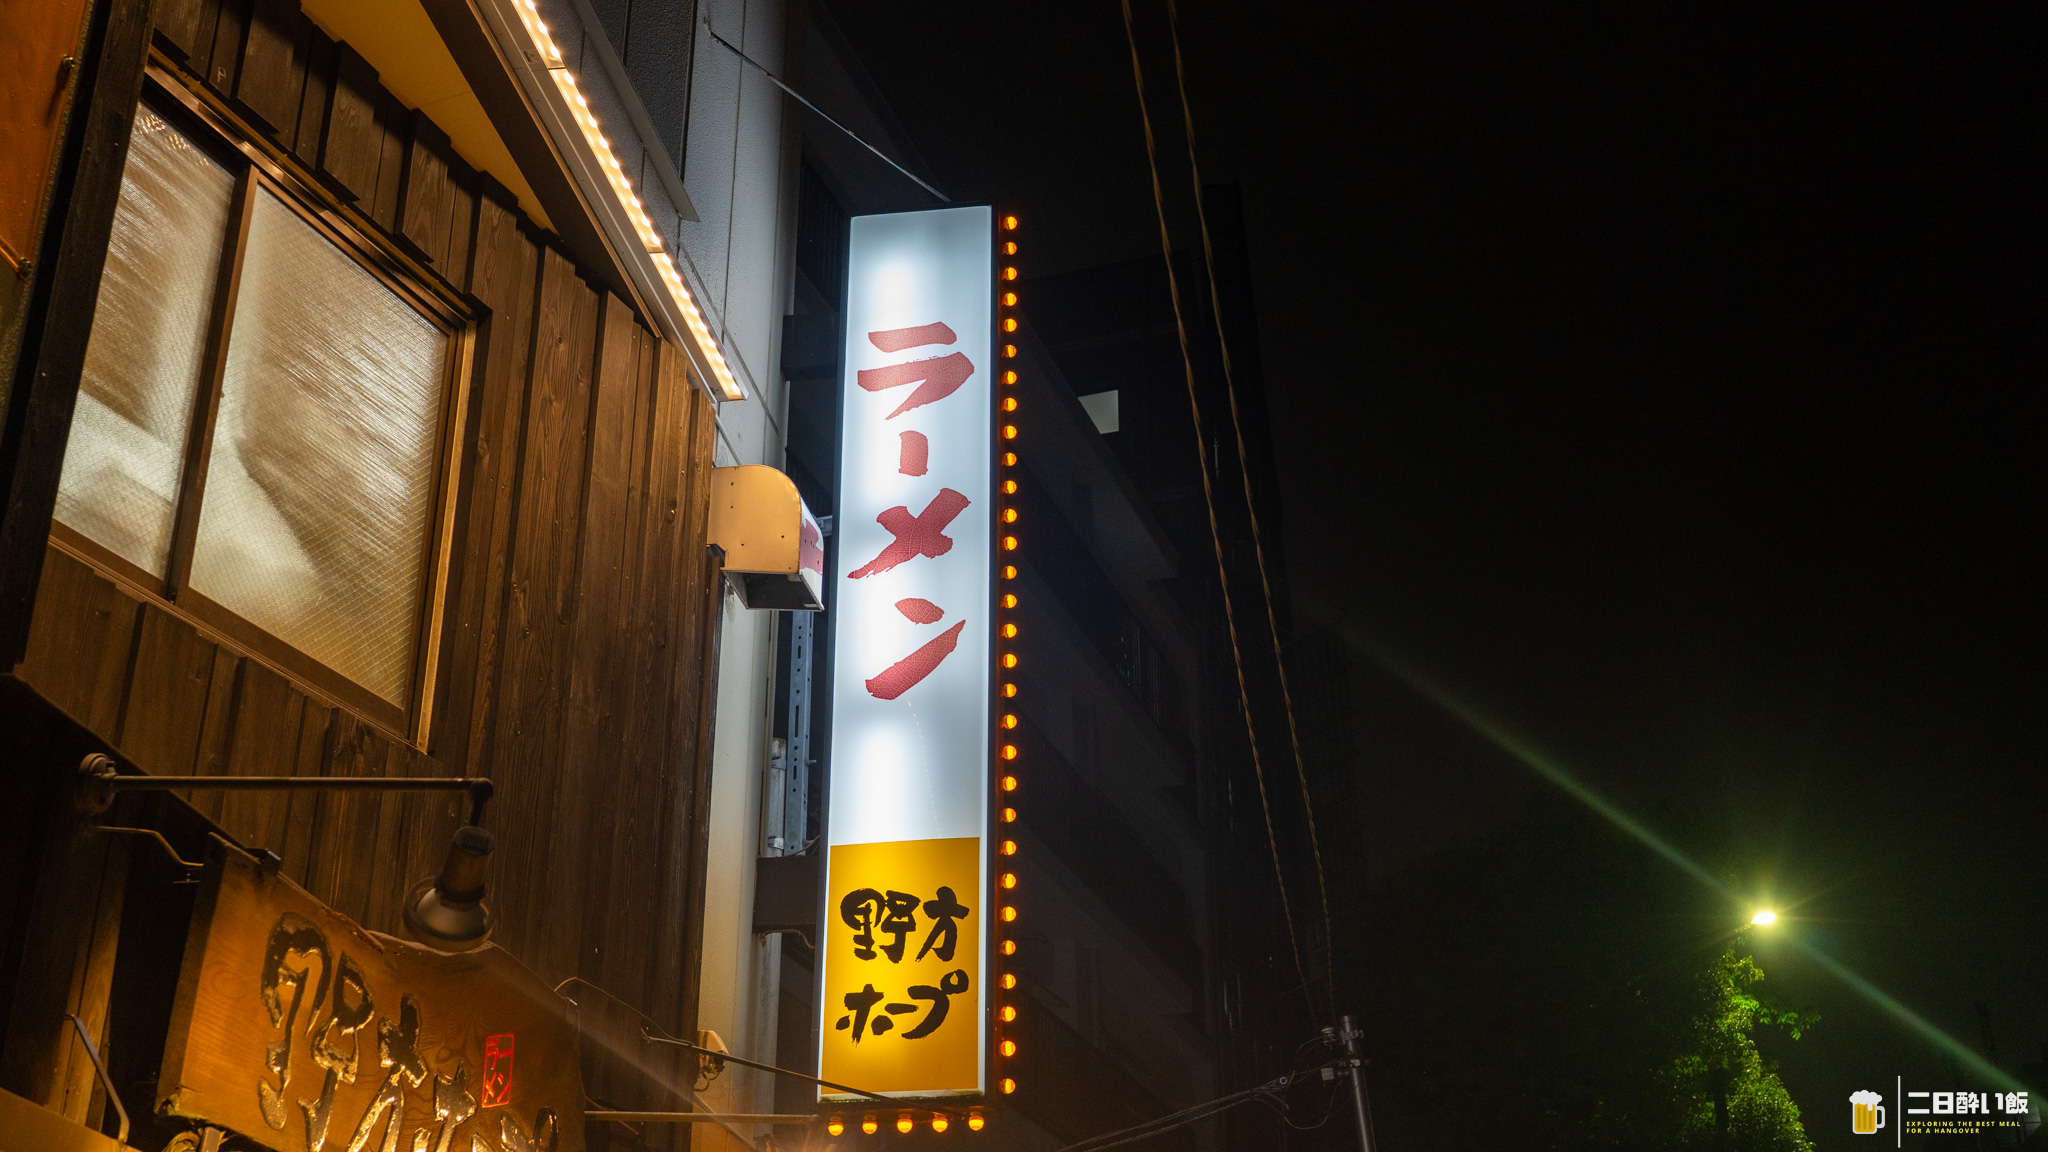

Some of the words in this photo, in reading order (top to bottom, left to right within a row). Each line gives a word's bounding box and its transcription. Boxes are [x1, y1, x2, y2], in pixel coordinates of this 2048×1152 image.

[847, 321, 975, 700] ラーメン
[840, 886, 970, 964] 野方
[835, 969, 969, 1047] ホープ
